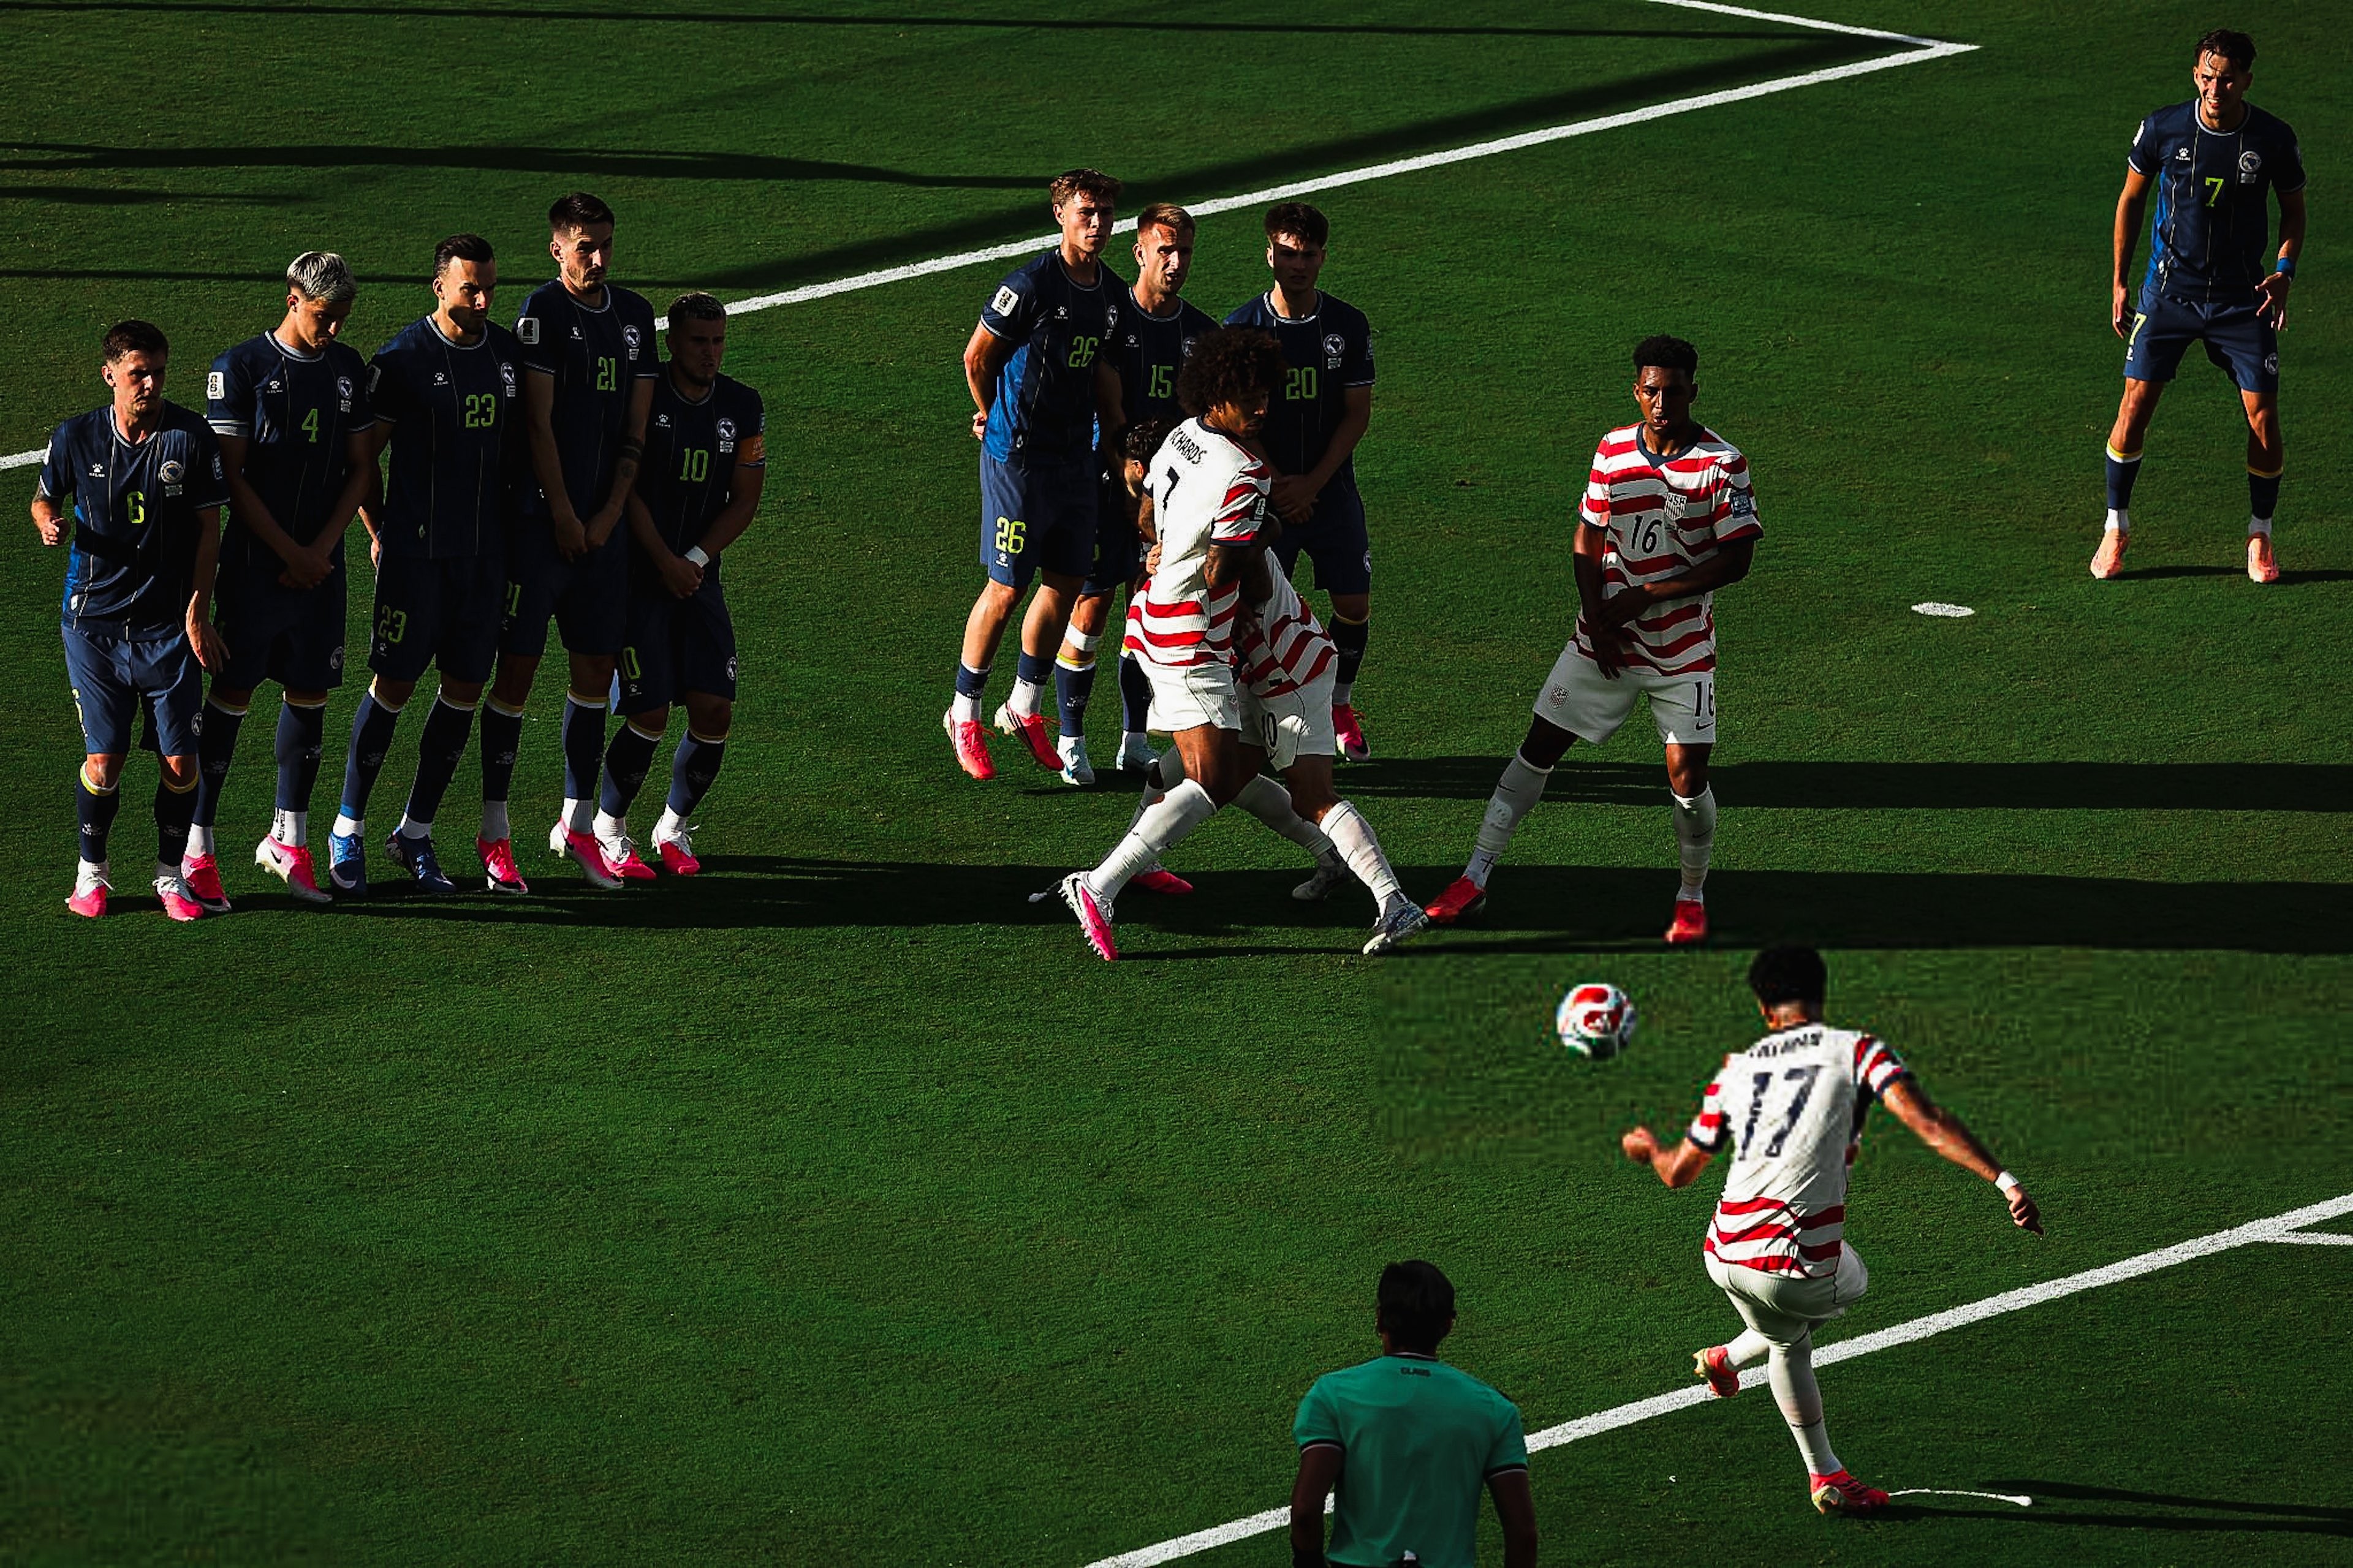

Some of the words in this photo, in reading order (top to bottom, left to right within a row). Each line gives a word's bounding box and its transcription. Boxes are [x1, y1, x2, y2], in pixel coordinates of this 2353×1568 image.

[2205, 176, 2224, 208] 7
[2129, 312, 2147, 347] 7
[1068, 335, 1099, 368] 26
[596, 355, 617, 392] 21
[1148, 364, 1176, 400] 15
[1286, 366, 1319, 401] 20
[301, 407, 319, 443] 4
[464, 393, 497, 428] 23
[679, 447, 710, 483] 10
[126, 490, 145, 525] 6
[995, 516, 1027, 555] 26
[1632, 514, 1663, 553] 16
[377, 604, 409, 644] 23
[1738, 1064, 1822, 1161] 17
